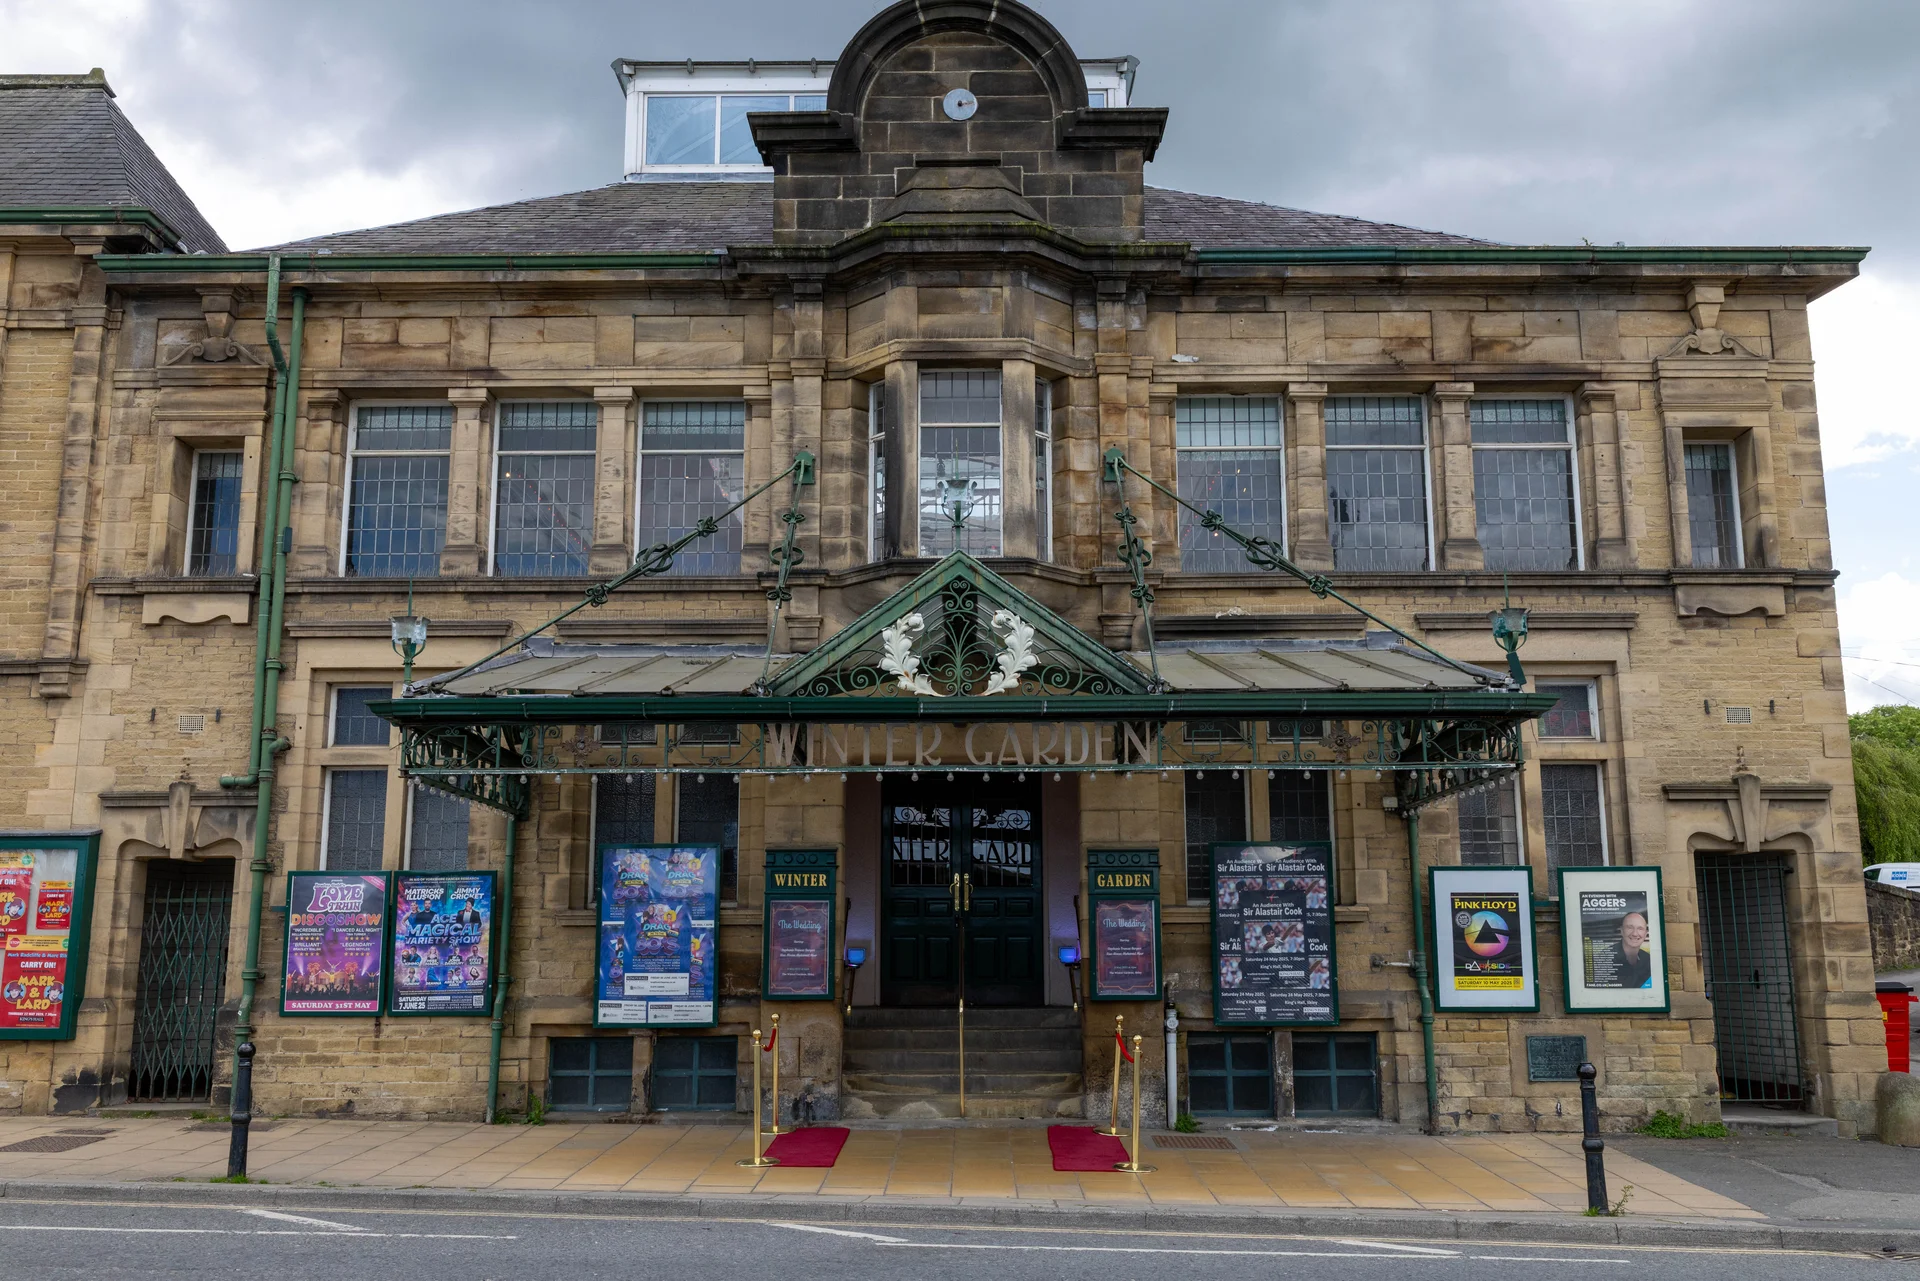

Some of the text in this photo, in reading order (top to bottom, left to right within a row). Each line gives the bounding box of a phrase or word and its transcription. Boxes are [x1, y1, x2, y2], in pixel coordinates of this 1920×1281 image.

[766, 721, 1152, 766] WINTER GARDEN
[973, 837, 1031, 864] GARD
[775, 874, 827, 886] WINTER
[1097, 874, 1150, 887] GARDEN
[306, 884, 363, 912] LOVE
[1582, 899, 1626, 907] AGGERS
[328, 902, 361, 912] TRAIN
[291, 914, 381, 925] DISCOSHOW
[431, 914, 457, 923] ACE
[1103, 918, 1146, 931] The Wedding
[407, 924, 482, 936] MAGICAL
[778, 919, 822, 933] The Wedding
[18, 976, 55, 986] MARK
[29, 987, 40, 998] &
[16, 998, 51, 1010] LARD
